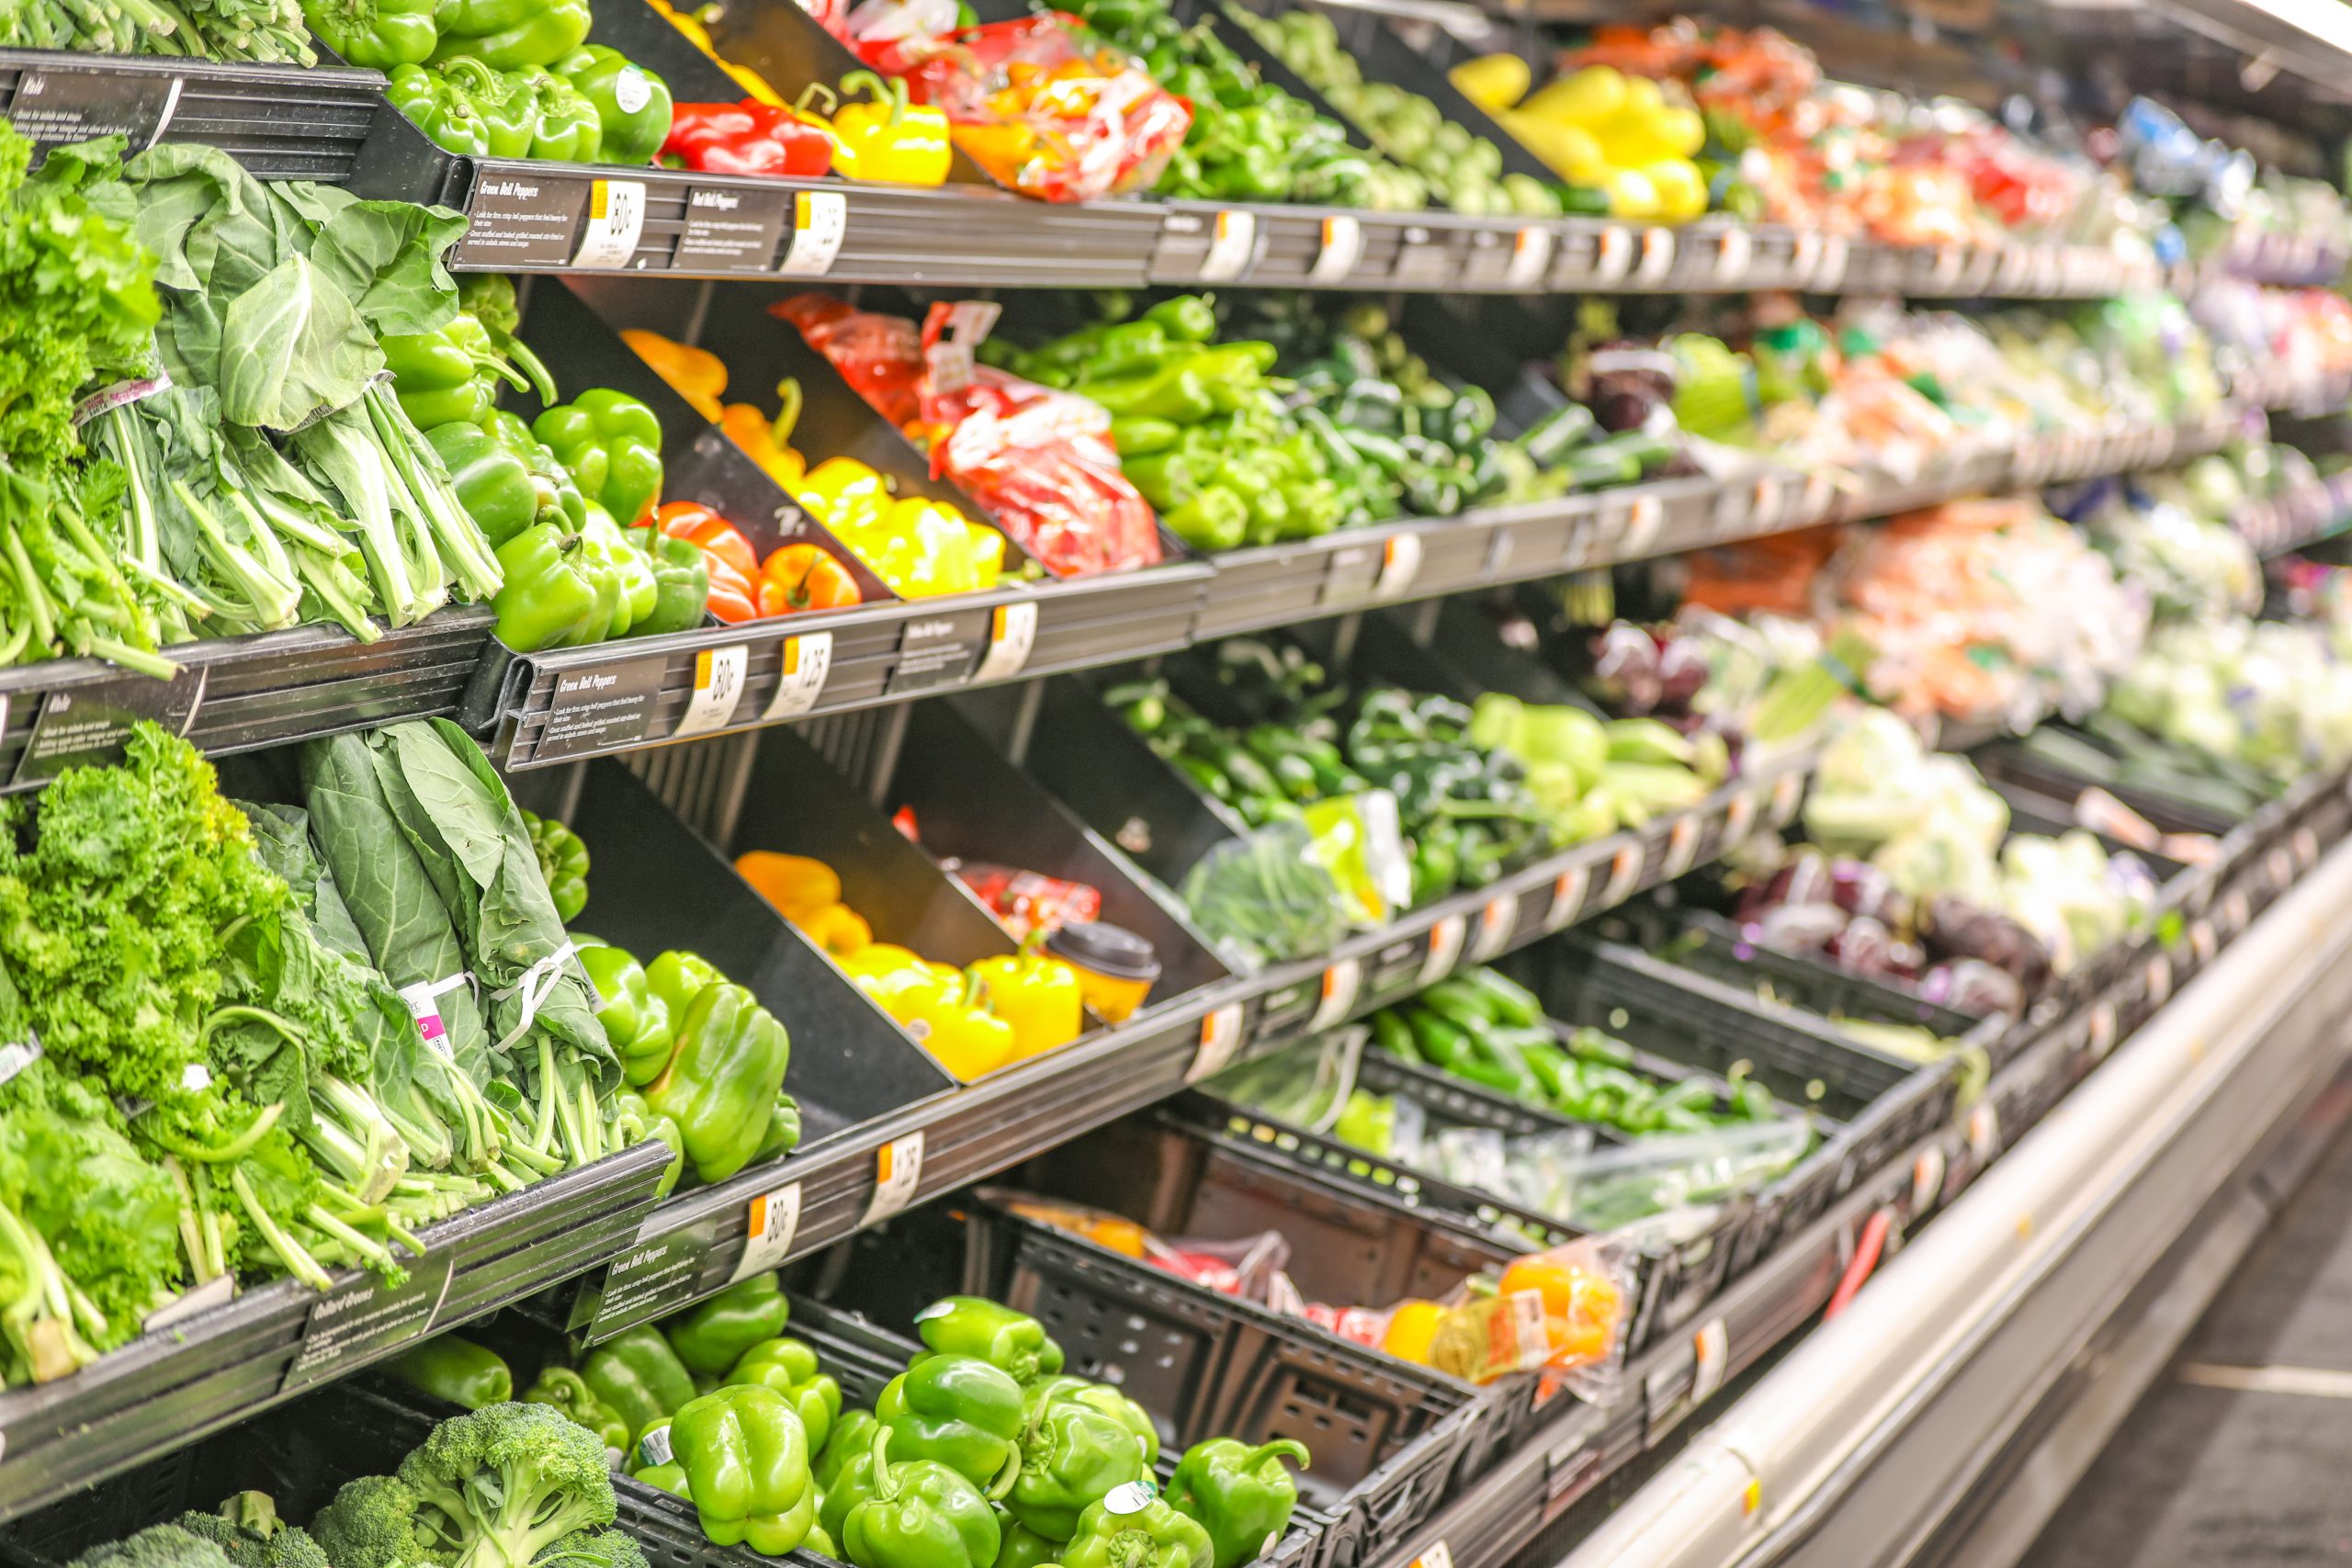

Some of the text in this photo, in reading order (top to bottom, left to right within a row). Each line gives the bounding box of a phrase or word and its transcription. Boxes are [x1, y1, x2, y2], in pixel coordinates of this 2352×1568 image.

[480, 181, 538, 200] Green Bell Peppers
[560, 673, 617, 693] Green Bell Peppers
[612, 1245, 668, 1276] Green Bell Peppers
